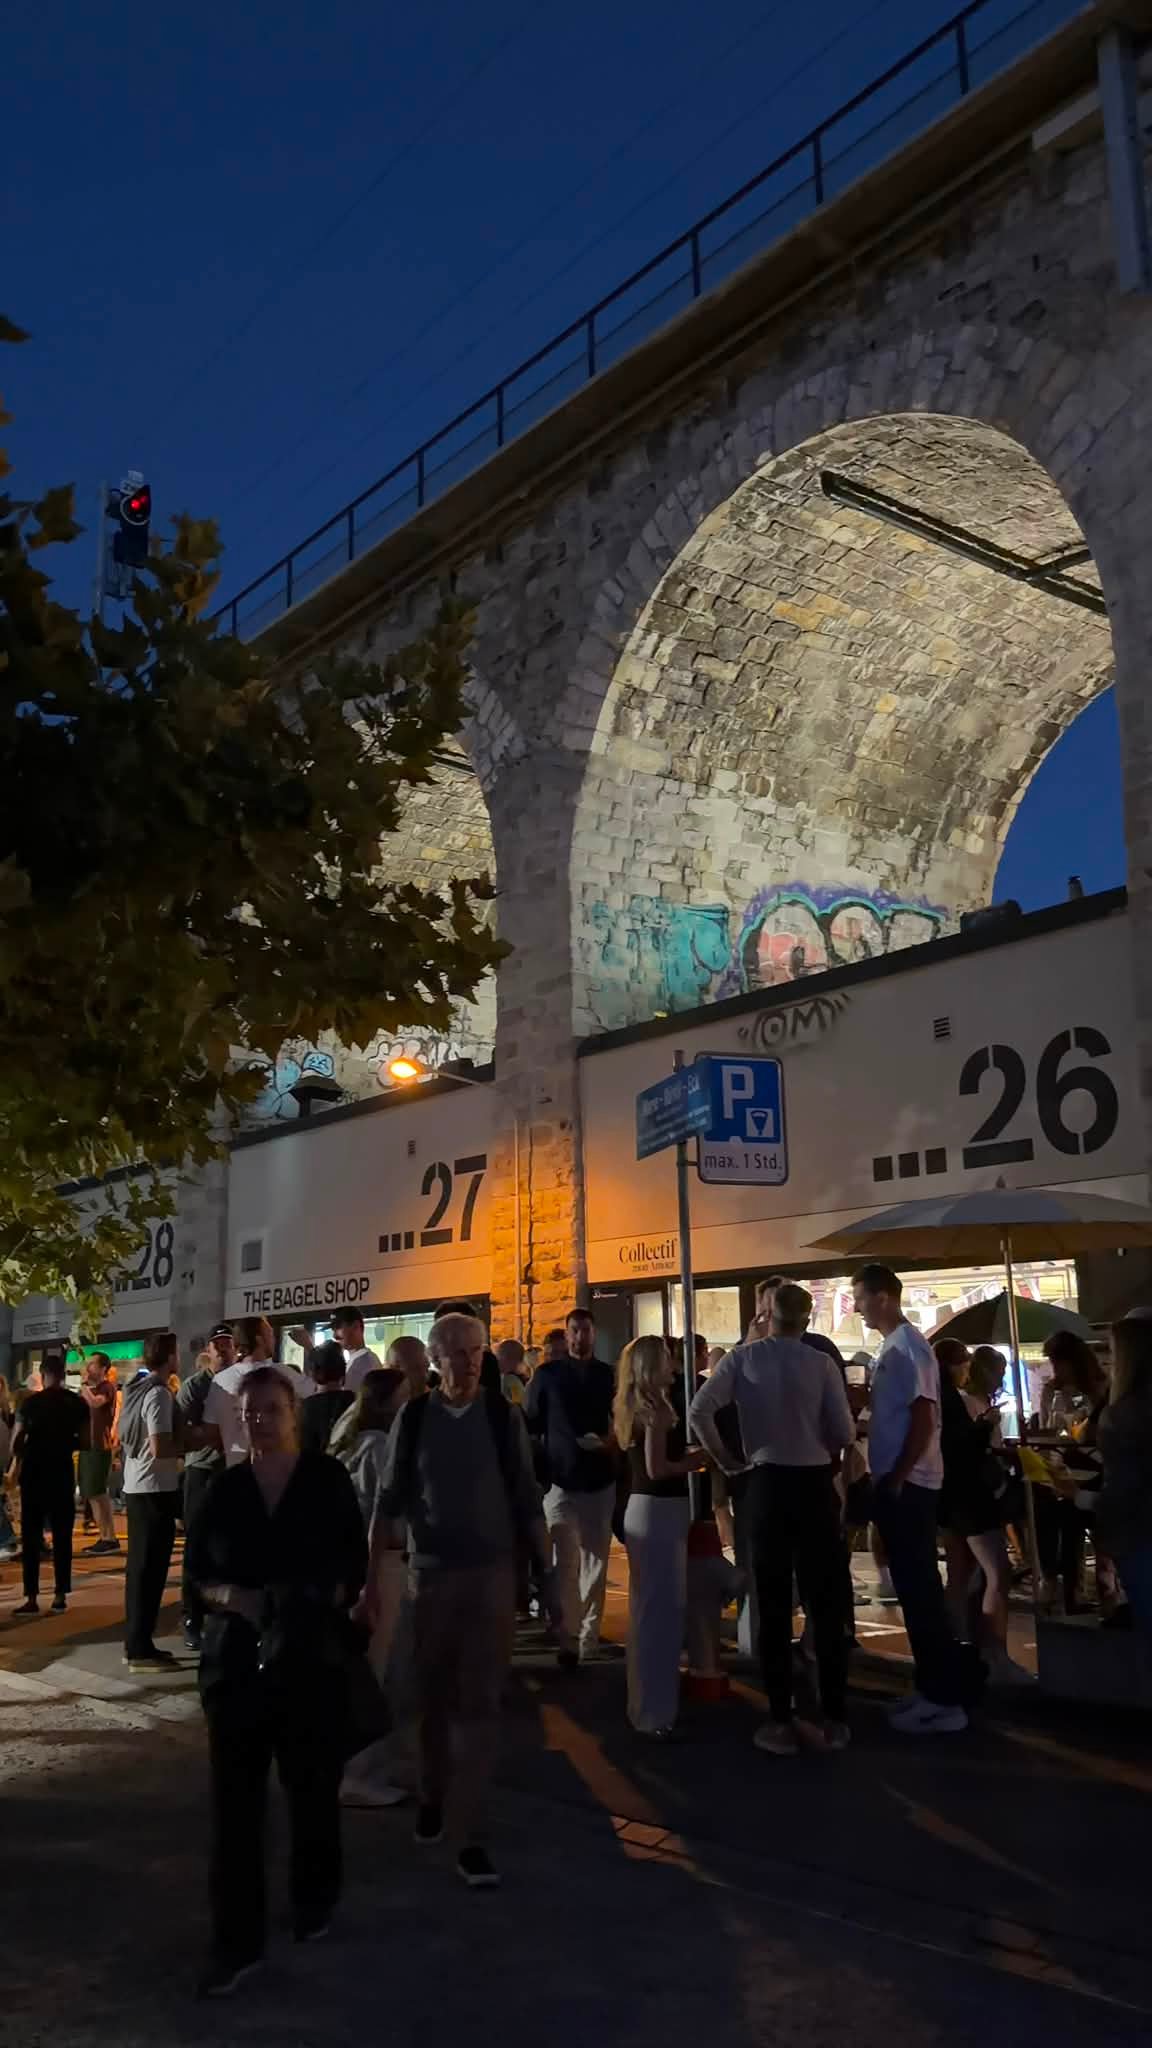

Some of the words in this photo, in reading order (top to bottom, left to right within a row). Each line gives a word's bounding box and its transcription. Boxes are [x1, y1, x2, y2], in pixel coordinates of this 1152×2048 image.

[720, 1064, 755, 1120] P
[704, 1154, 739, 1169] max.
[743, 1153, 750, 1169] 1
[754, 1153, 783, 1170] Std.
[619, 1238, 678, 1264] Collectif
[243, 1289, 271, 1313] THE
[273, 1283, 323, 1310] BAGEL
[324, 1277, 370, 1304] SHOP
